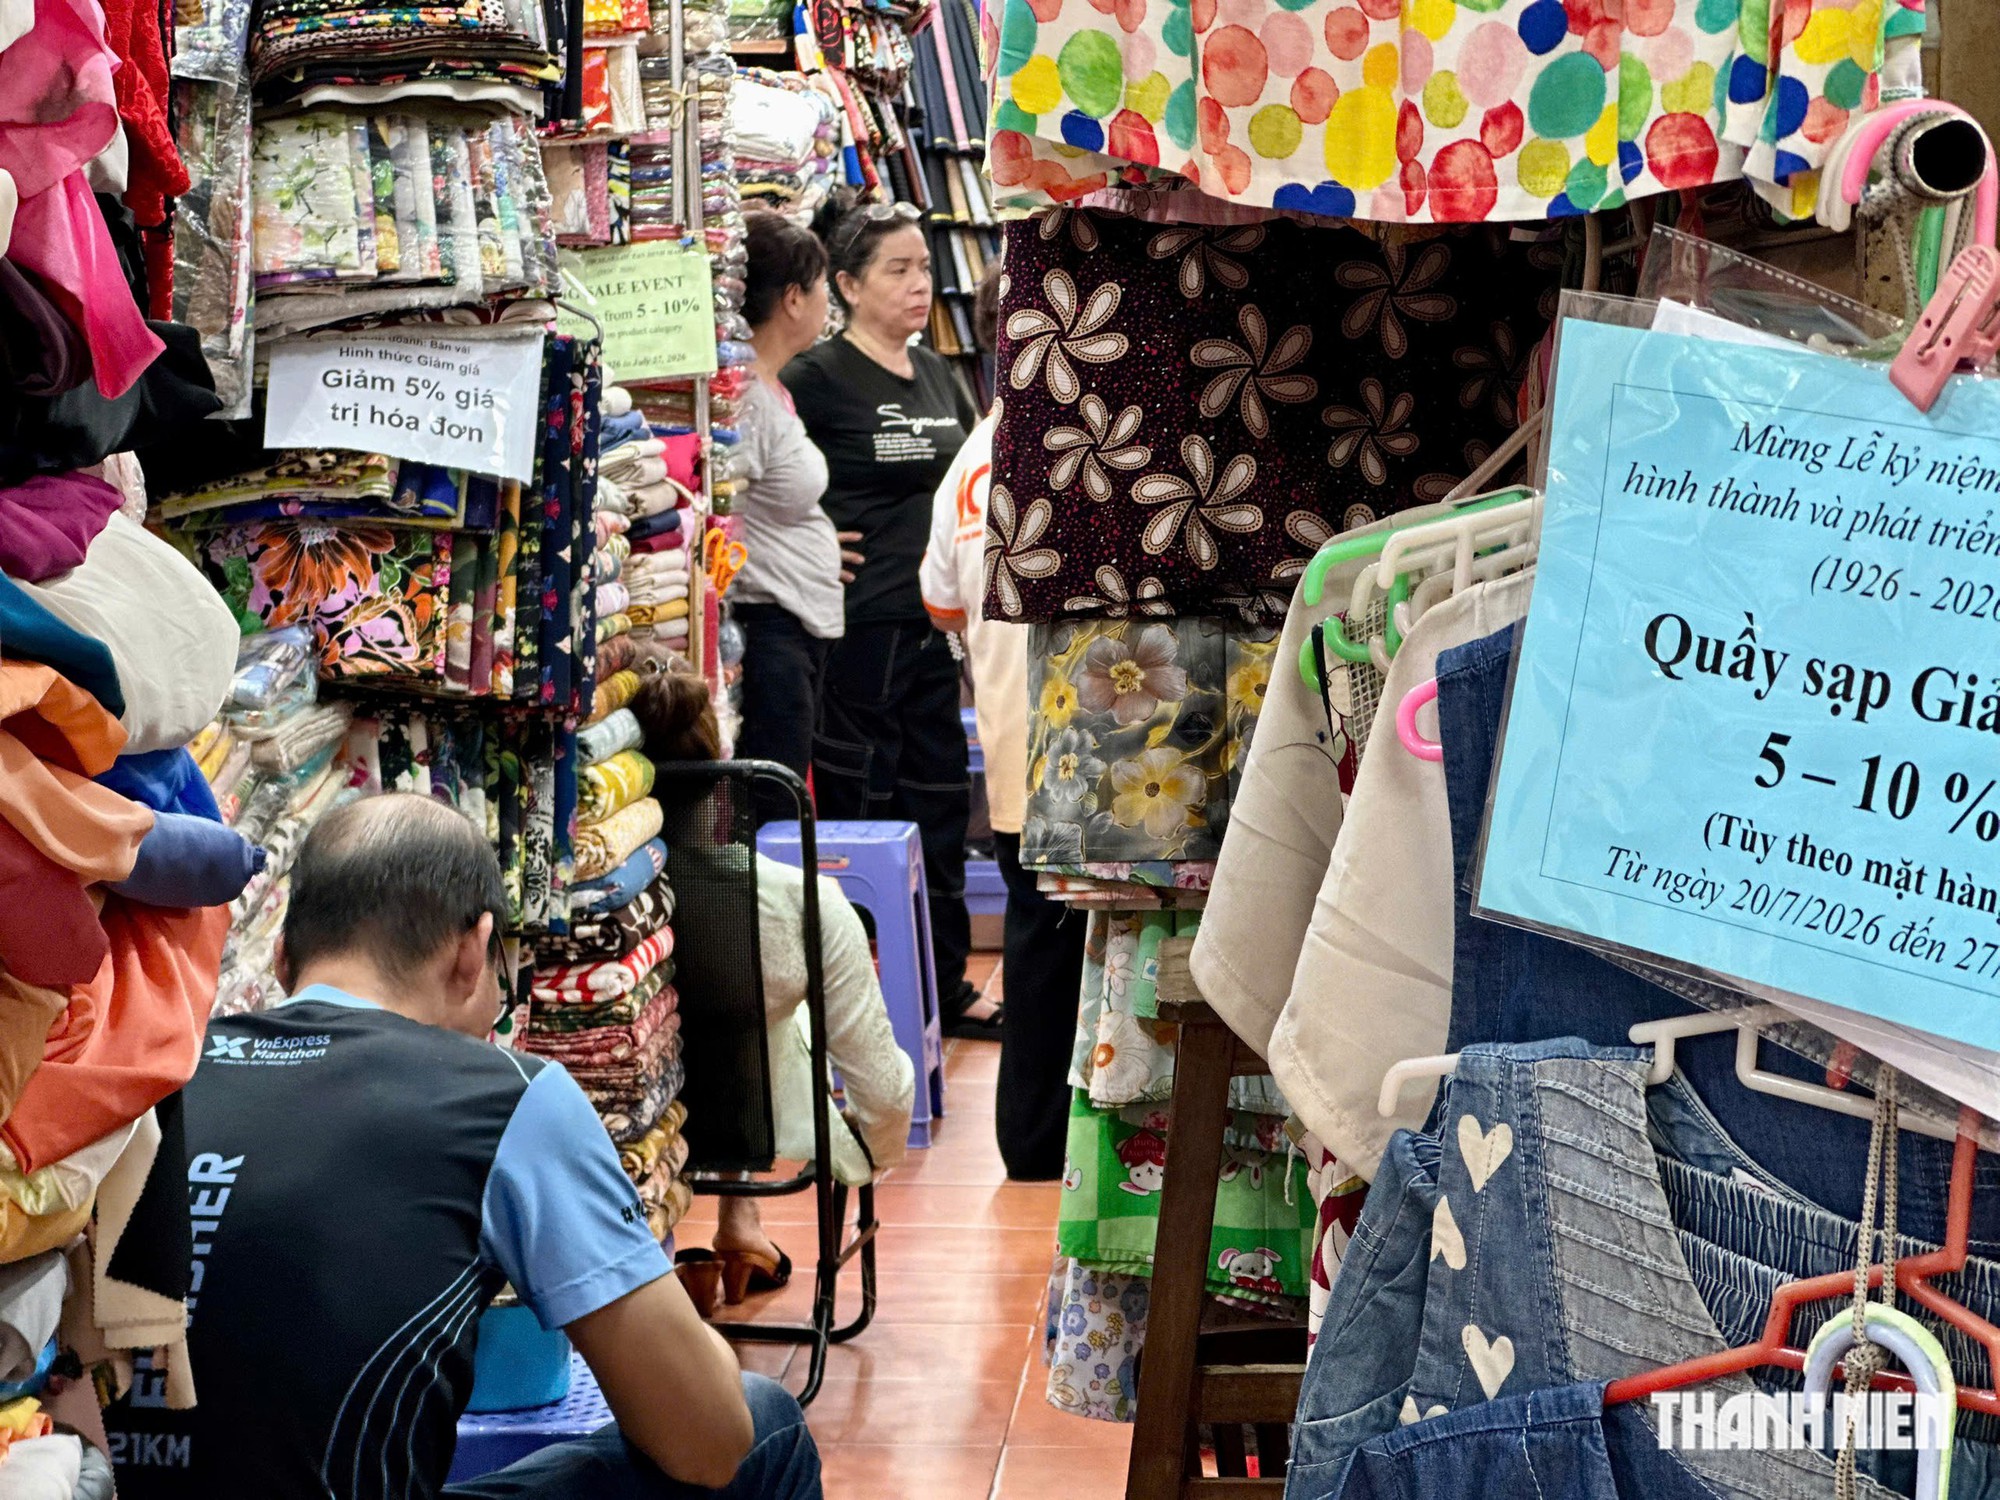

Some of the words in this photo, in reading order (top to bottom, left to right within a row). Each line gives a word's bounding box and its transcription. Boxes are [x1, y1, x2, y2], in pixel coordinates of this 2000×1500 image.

[587, 280, 628, 298] SALE
[631, 276, 686, 293] EVENT
[604, 309, 633, 322] from
[637, 303, 646, 318] 5
[663, 297, 700, 316] 10%
[618, 327, 648, 340] product
[649, 324, 682, 336] category
[379, 349, 413, 364] thức
[459, 363, 480, 377] giá
[632, 355, 651, 368] July
[667, 352, 687, 364] 2026
[322, 368, 395, 394] Giảm
[405, 376, 445, 402] 5%
[455, 387, 495, 411] giá
[330, 402, 360, 427] trị
[370, 404, 420, 432] hóa
[430, 416, 484, 444] đơn
[1731, 420, 1831, 474] Mừng
[1835, 430, 1884, 472] Lễ
[1881, 442, 1921, 487] kỷ
[1926, 455, 2000, 495] niệm
[1622, 462, 1699, 503] hình
[1707, 475, 1800, 522] thành
[1809, 495, 1844, 529] và
[1843, 501, 1922, 542] phát
[1927, 509, 2000, 557] triển
[1810, 555, 1904, 602] (1926
[1643, 610, 1790, 700] Quầy
[1802, 656, 1892, 723] sạp
[1754, 731, 1792, 790] 5
[1852, 754, 1920, 820] 10
[1944, 772, 2000, 842] %
[1702, 811, 1778, 864] (Tùy
[1786, 833, 1854, 877] theo
[1862, 856, 1928, 901] mặt
[1934, 866, 2000, 925] hàn
[1603, 845, 1648, 884] Từ
[1653, 861, 1726, 911] ngày
[1731, 879, 1887, 946] 20/7/2026
[1888, 916, 1947, 964] đến
[250, 1048, 327, 1060] Marathon
[253, 1034, 331, 1050] VnExpress
[107, 1431, 192, 1469] 21KM
